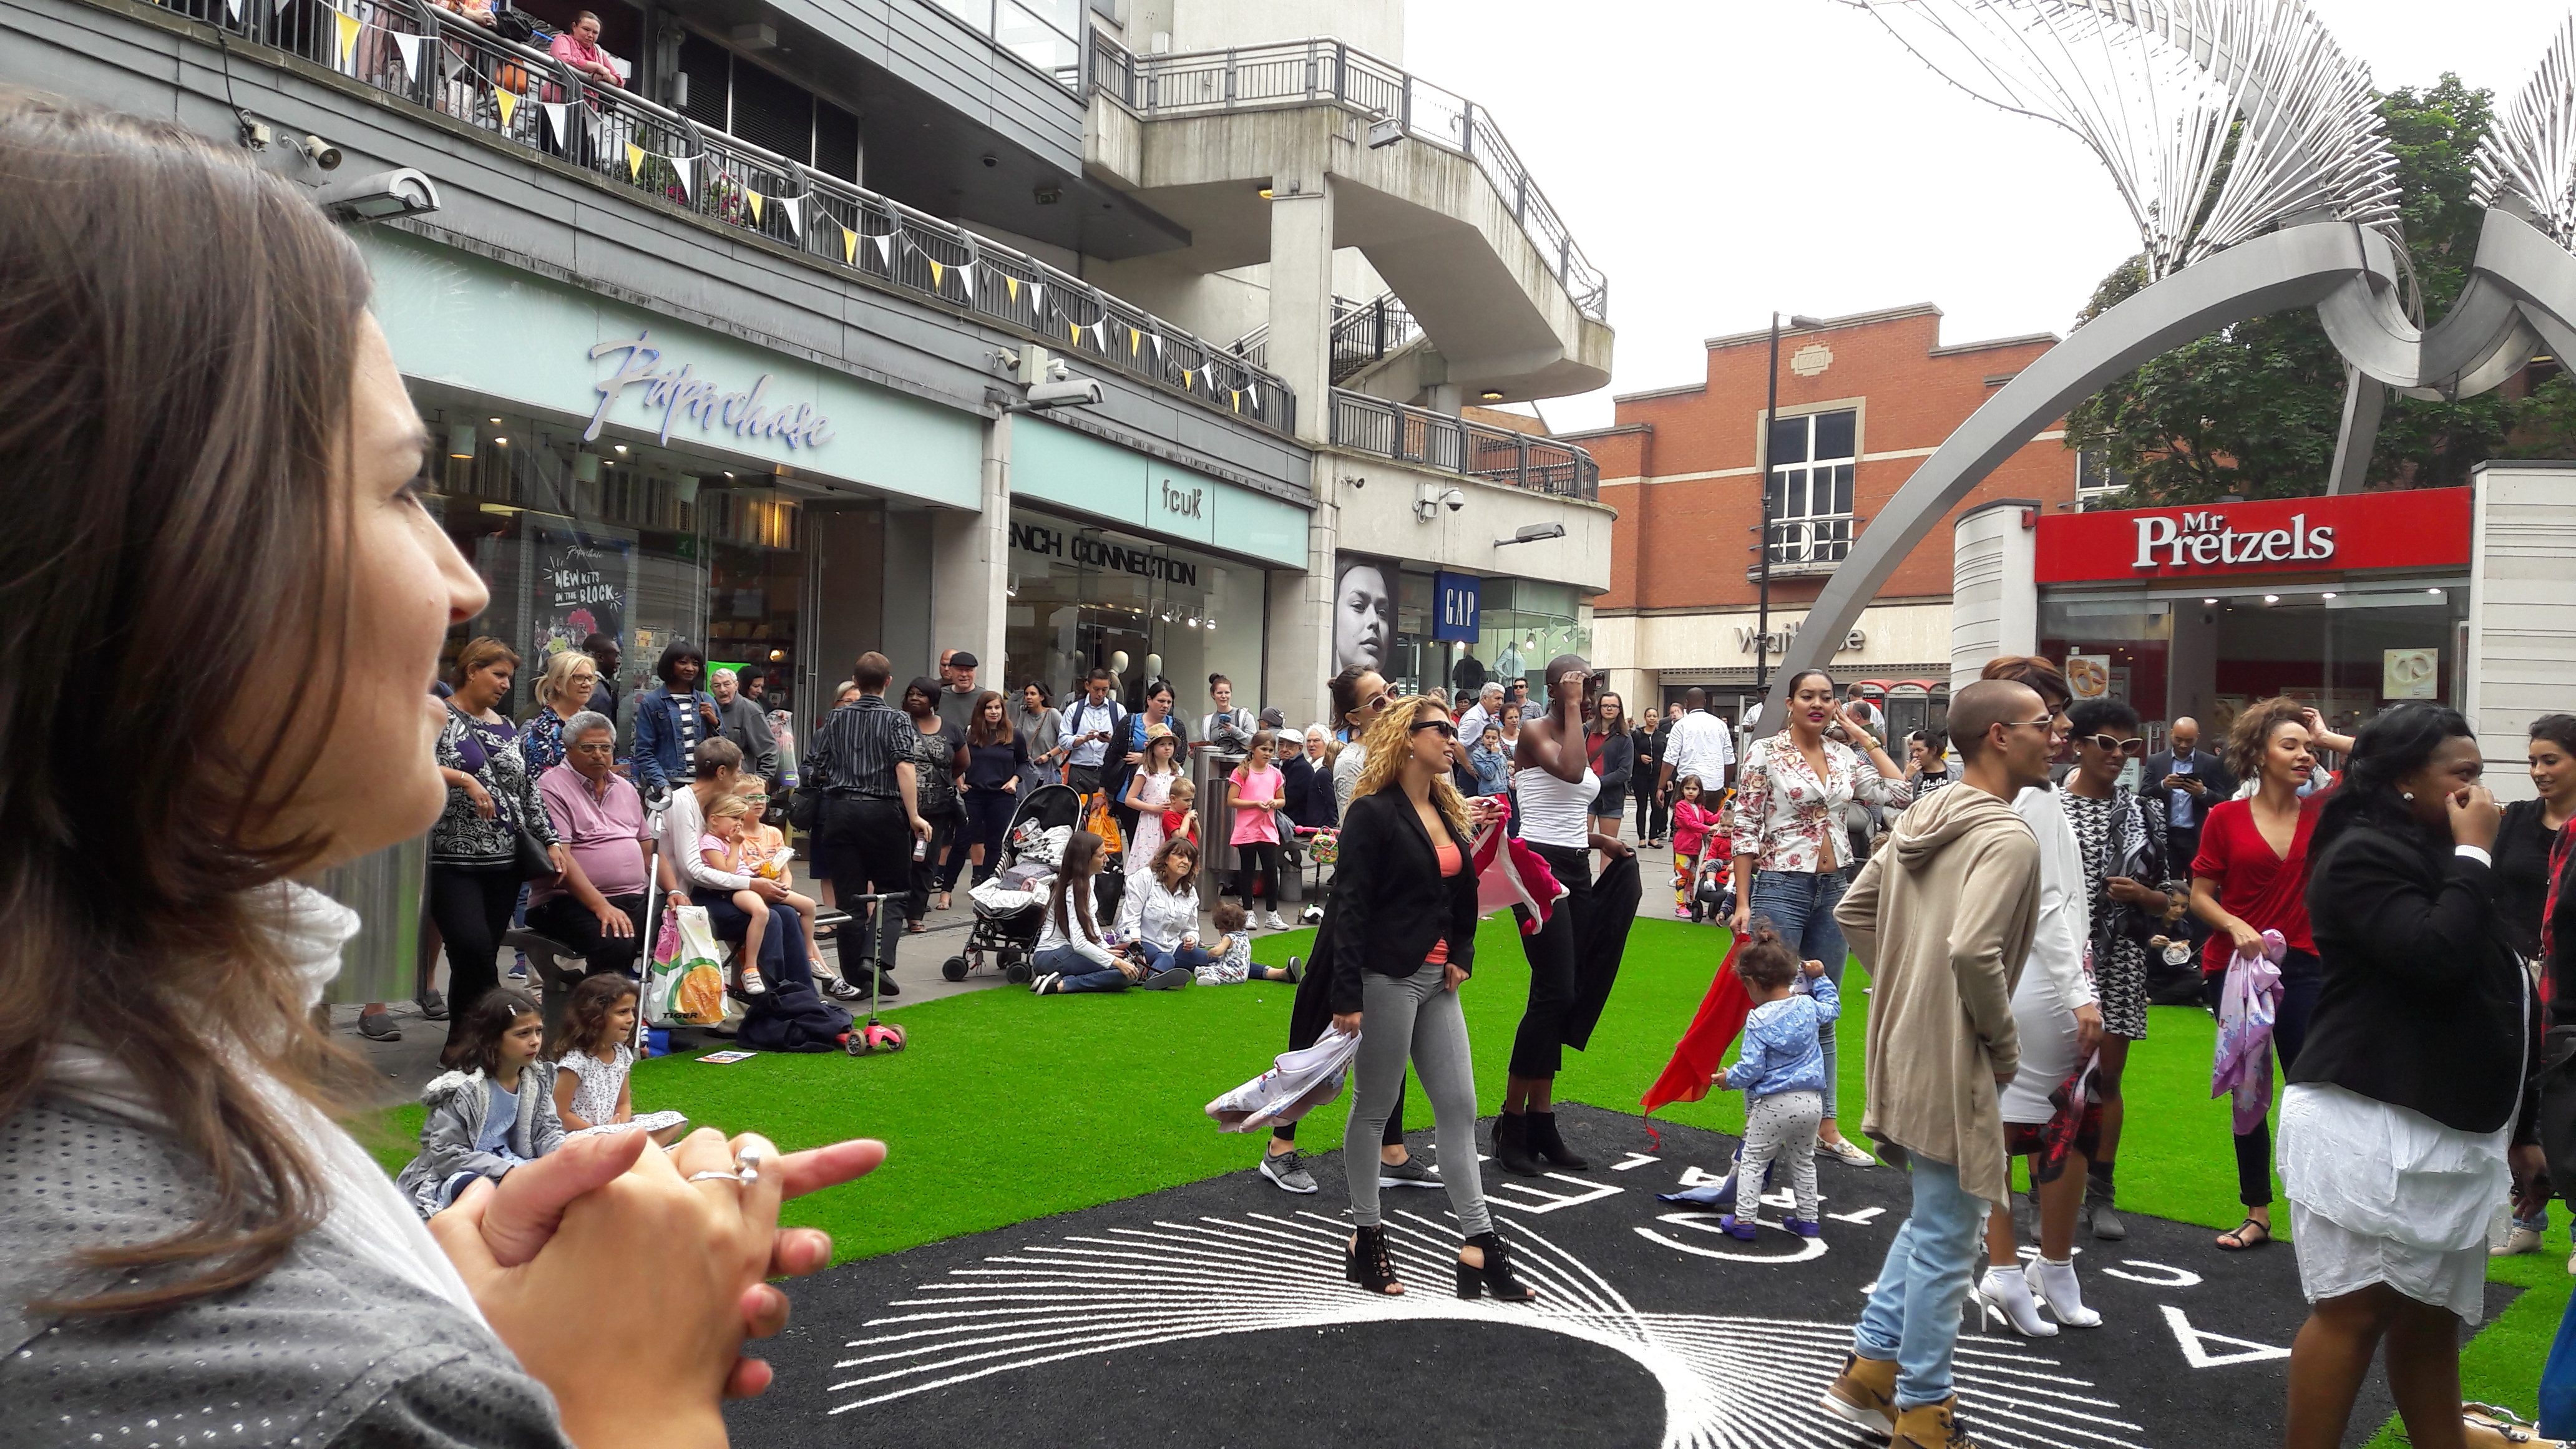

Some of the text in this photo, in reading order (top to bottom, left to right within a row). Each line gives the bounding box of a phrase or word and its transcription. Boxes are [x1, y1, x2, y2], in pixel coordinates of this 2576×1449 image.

[584, 330, 836, 449] Paperchase
[1162, 479, 1202, 520] fcuk
[2132, 513, 2335, 567] Pretzels
[2182, 511, 2225, 533] Mr
[1009, 522, 1196, 586] NCH CONNECTION
[555, 568, 579, 589] NEW
[555, 583, 615, 604] ON THE BLOCK
[1445, 588, 1475, 627] GAP
[1734, 621, 1866, 654] Waie
[1920, 778, 1948, 790] Hello
